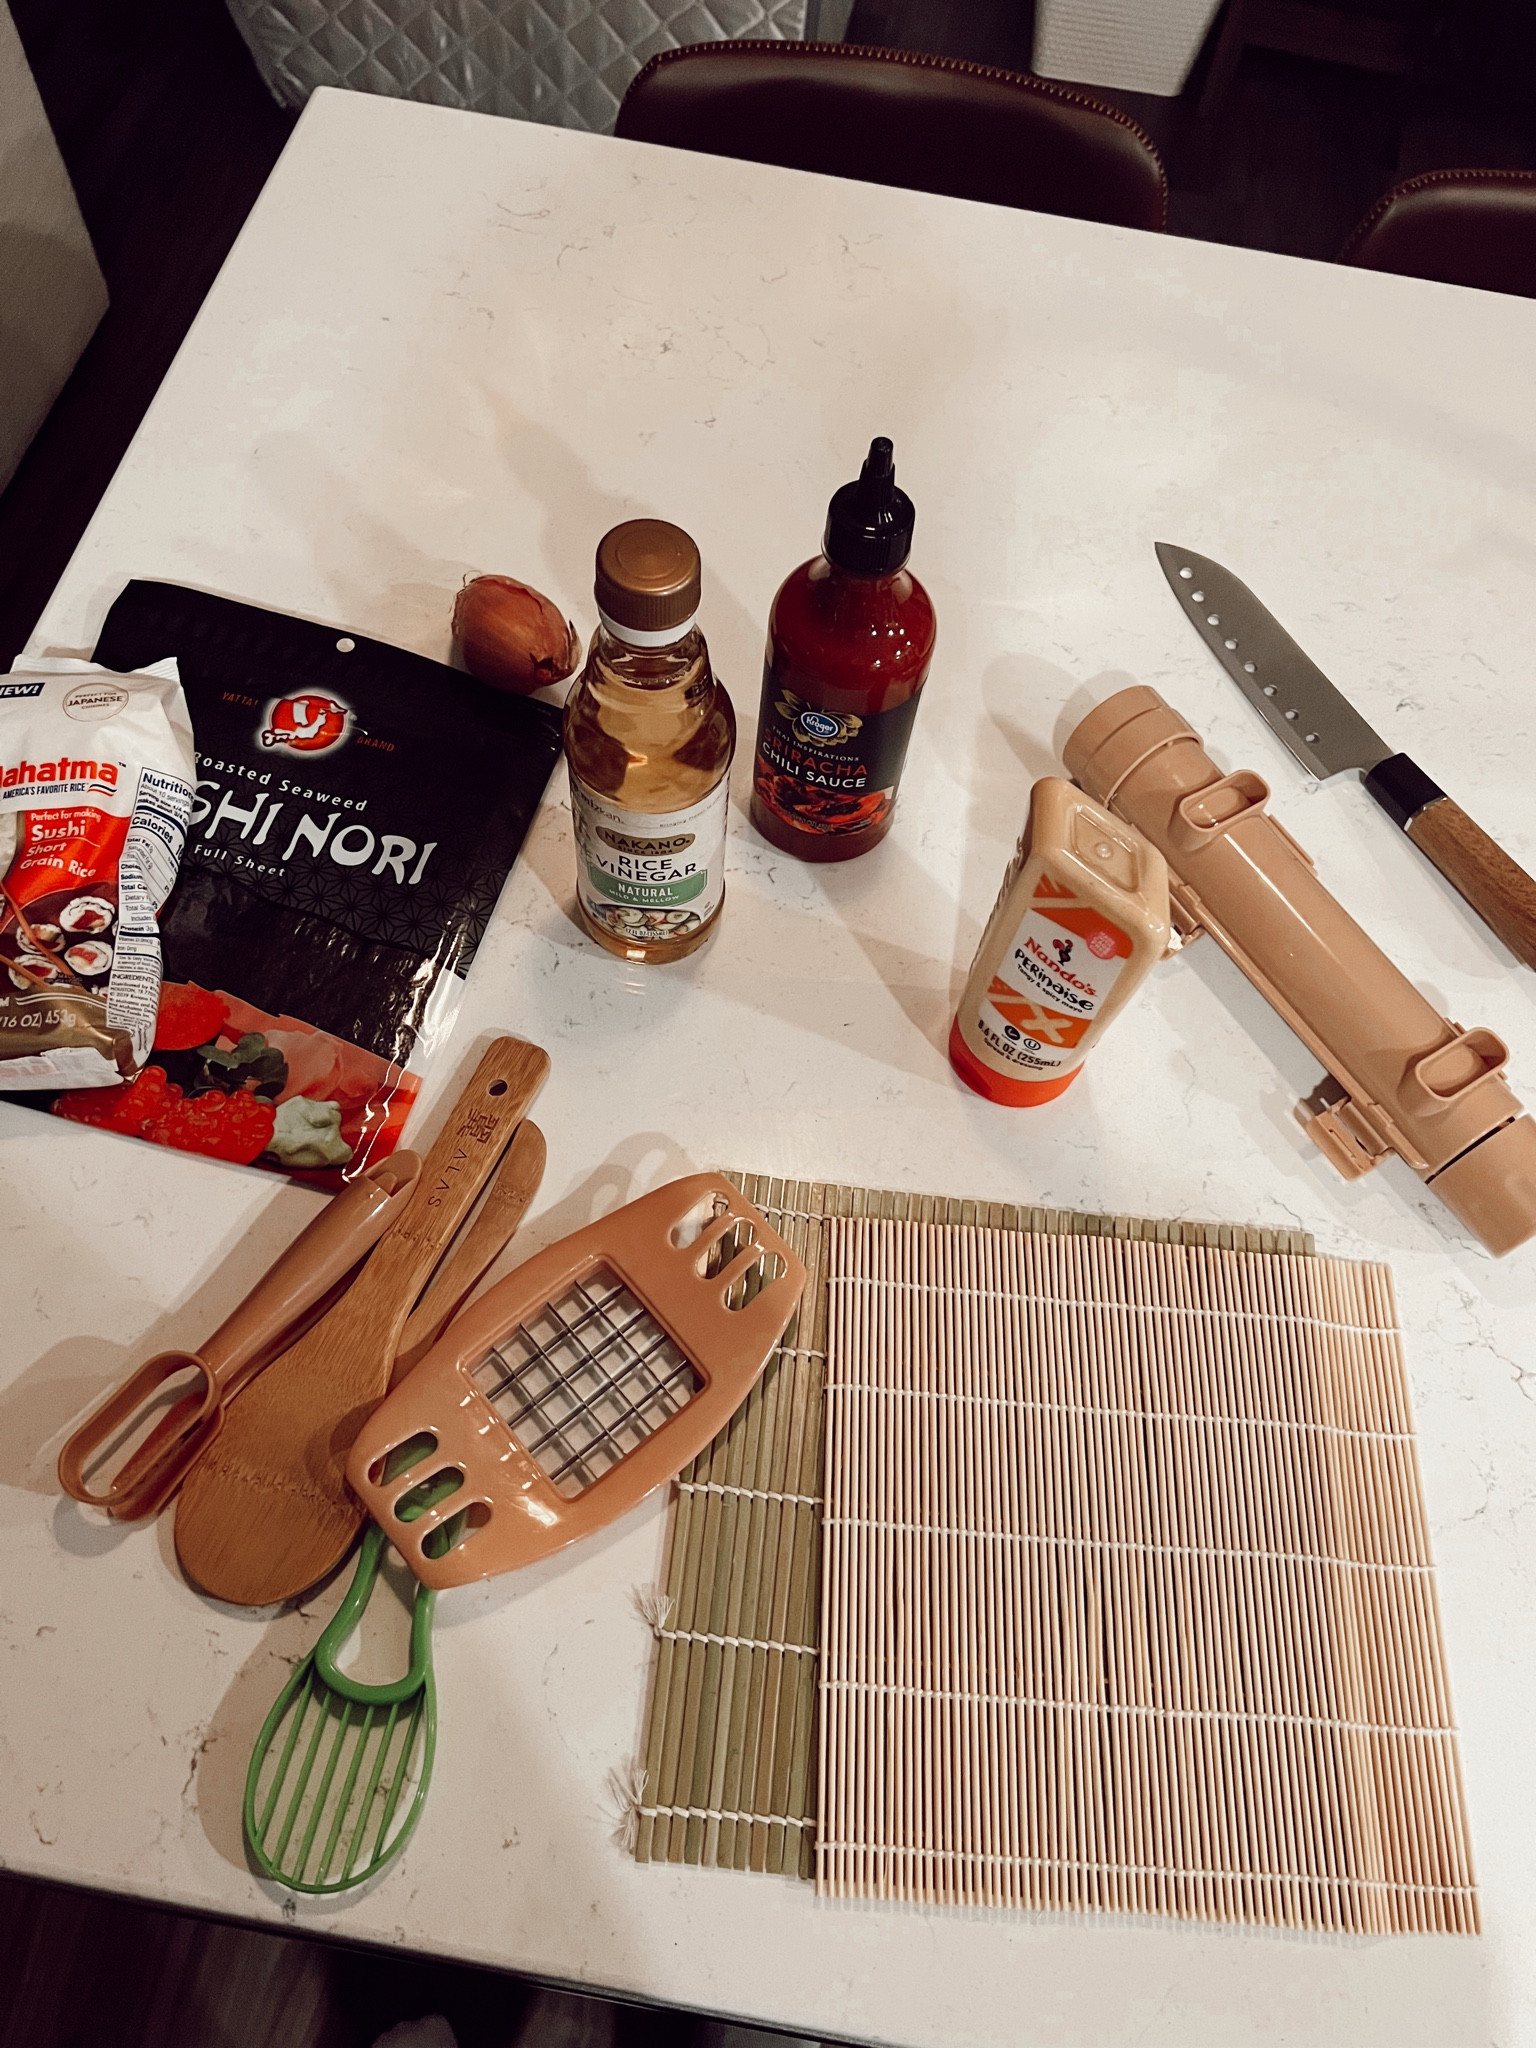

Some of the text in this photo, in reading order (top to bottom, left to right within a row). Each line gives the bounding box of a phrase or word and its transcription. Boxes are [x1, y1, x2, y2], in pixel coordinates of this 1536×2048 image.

[67, 696, 123, 706] JAPANESE
[222, 691, 259, 708] YATTA!
[806, 716, 834, 732] Kroger
[356, 736, 395, 752] BRAND
[764, 728, 868, 776] SRIRACHA
[793, 740, 859, 762] INSPIRATIONS
[762, 742, 867, 788] CHILI SAUCE
[3, 782, 86, 800] AMERICA'S FAVORITE RICE
[278, 779, 368, 811] Seaweed
[31, 808, 101, 823] Perfect for making
[31, 820, 86, 842] Sushi
[132, 816, 174, 844] Calories
[604, 830, 686, 850] NAKANO
[26, 842, 68, 857] Short
[281, 813, 438, 885] NORI
[20, 854, 96, 877] Grain Rice
[193, 844, 286, 877] Full Sheet
[595, 854, 697, 881] VINEGAR
[618, 855, 673, 871] RICE
[618, 883, 674, 897] NATURAL
[1024, 936, 1097, 997] Nando's
[1017, 964, 1035, 983] Tangy
[1042, 988, 1061, 1003] spicy
[1061, 1001, 1082, 1013] mayo
[20, 1011, 43, 1028] OZ)
[45, 1009, 76, 1028] 453g
[990, 1033, 1000, 1047] FL
[1002, 1043, 1016, 1056] OZ
[1017, 1051, 1061, 1067] (255mL)
